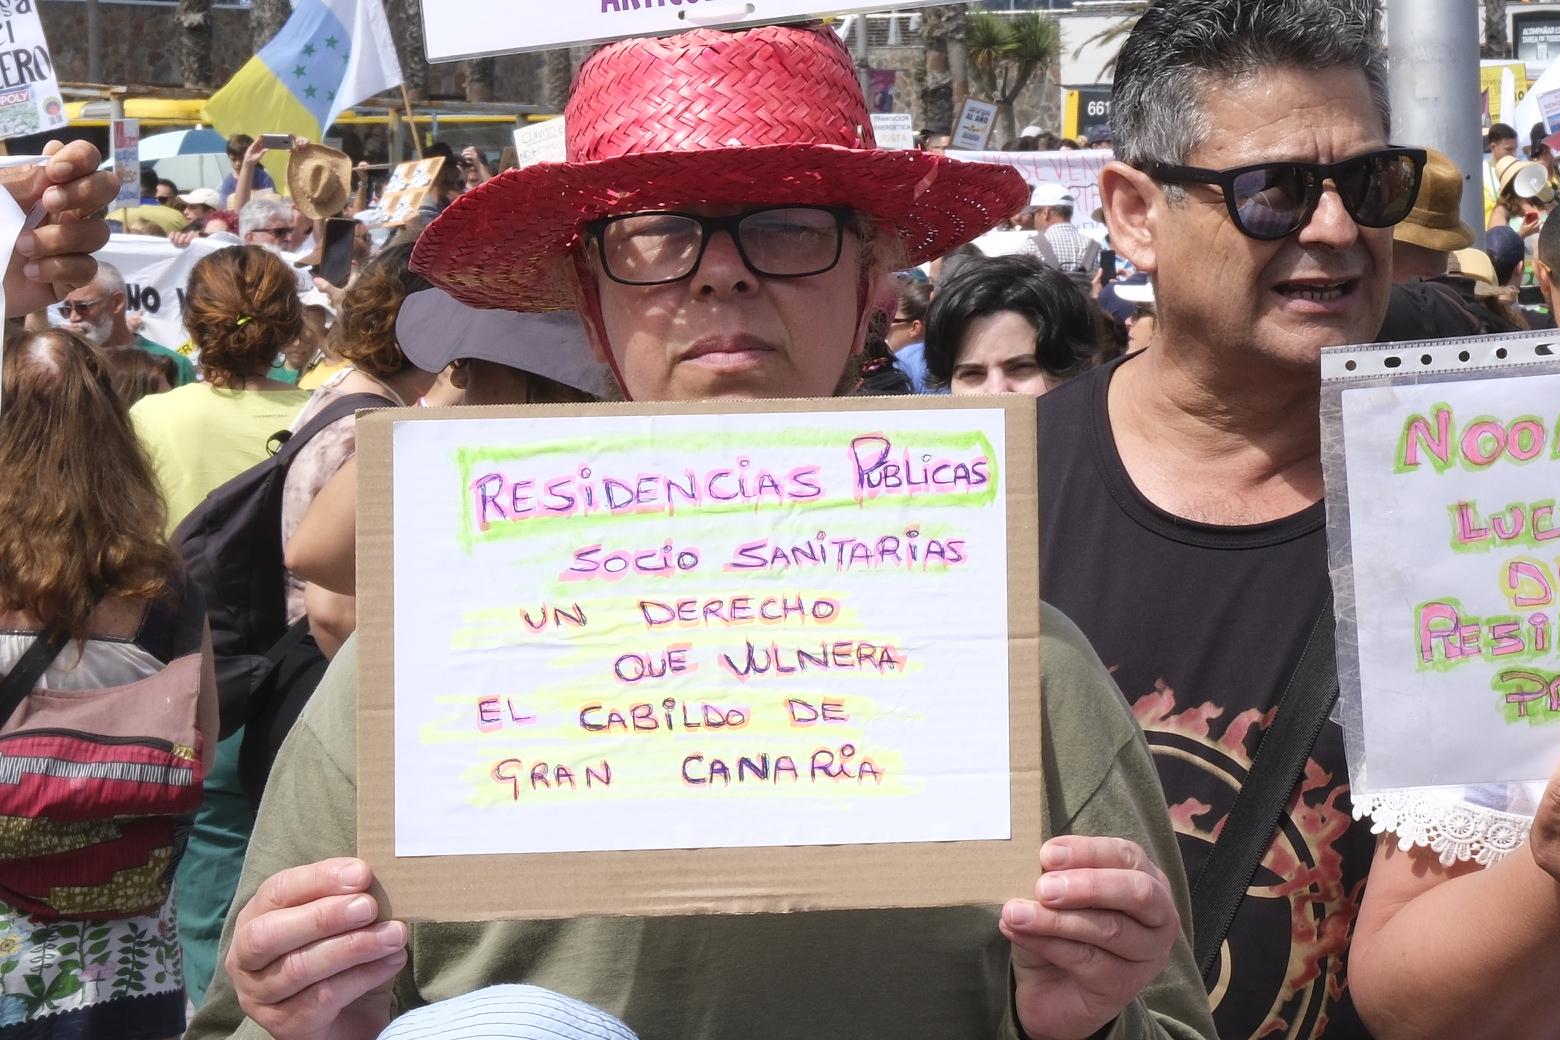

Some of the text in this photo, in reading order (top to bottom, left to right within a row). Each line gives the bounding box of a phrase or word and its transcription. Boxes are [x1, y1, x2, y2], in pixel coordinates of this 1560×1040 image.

[0, 45, 52, 89] ERO
[474, 435, 988, 528] RESIDENCIAS PUBLICAS
[566, 530, 968, 577] SOCIO SANITARIAS
[520, 596, 838, 631] UN DERECHO
[614, 640, 902, 685] QUE VULNERA
[477, 697, 850, 731] EL CABILDO DE
[491, 743, 883, 801] GRAN CANARIA
